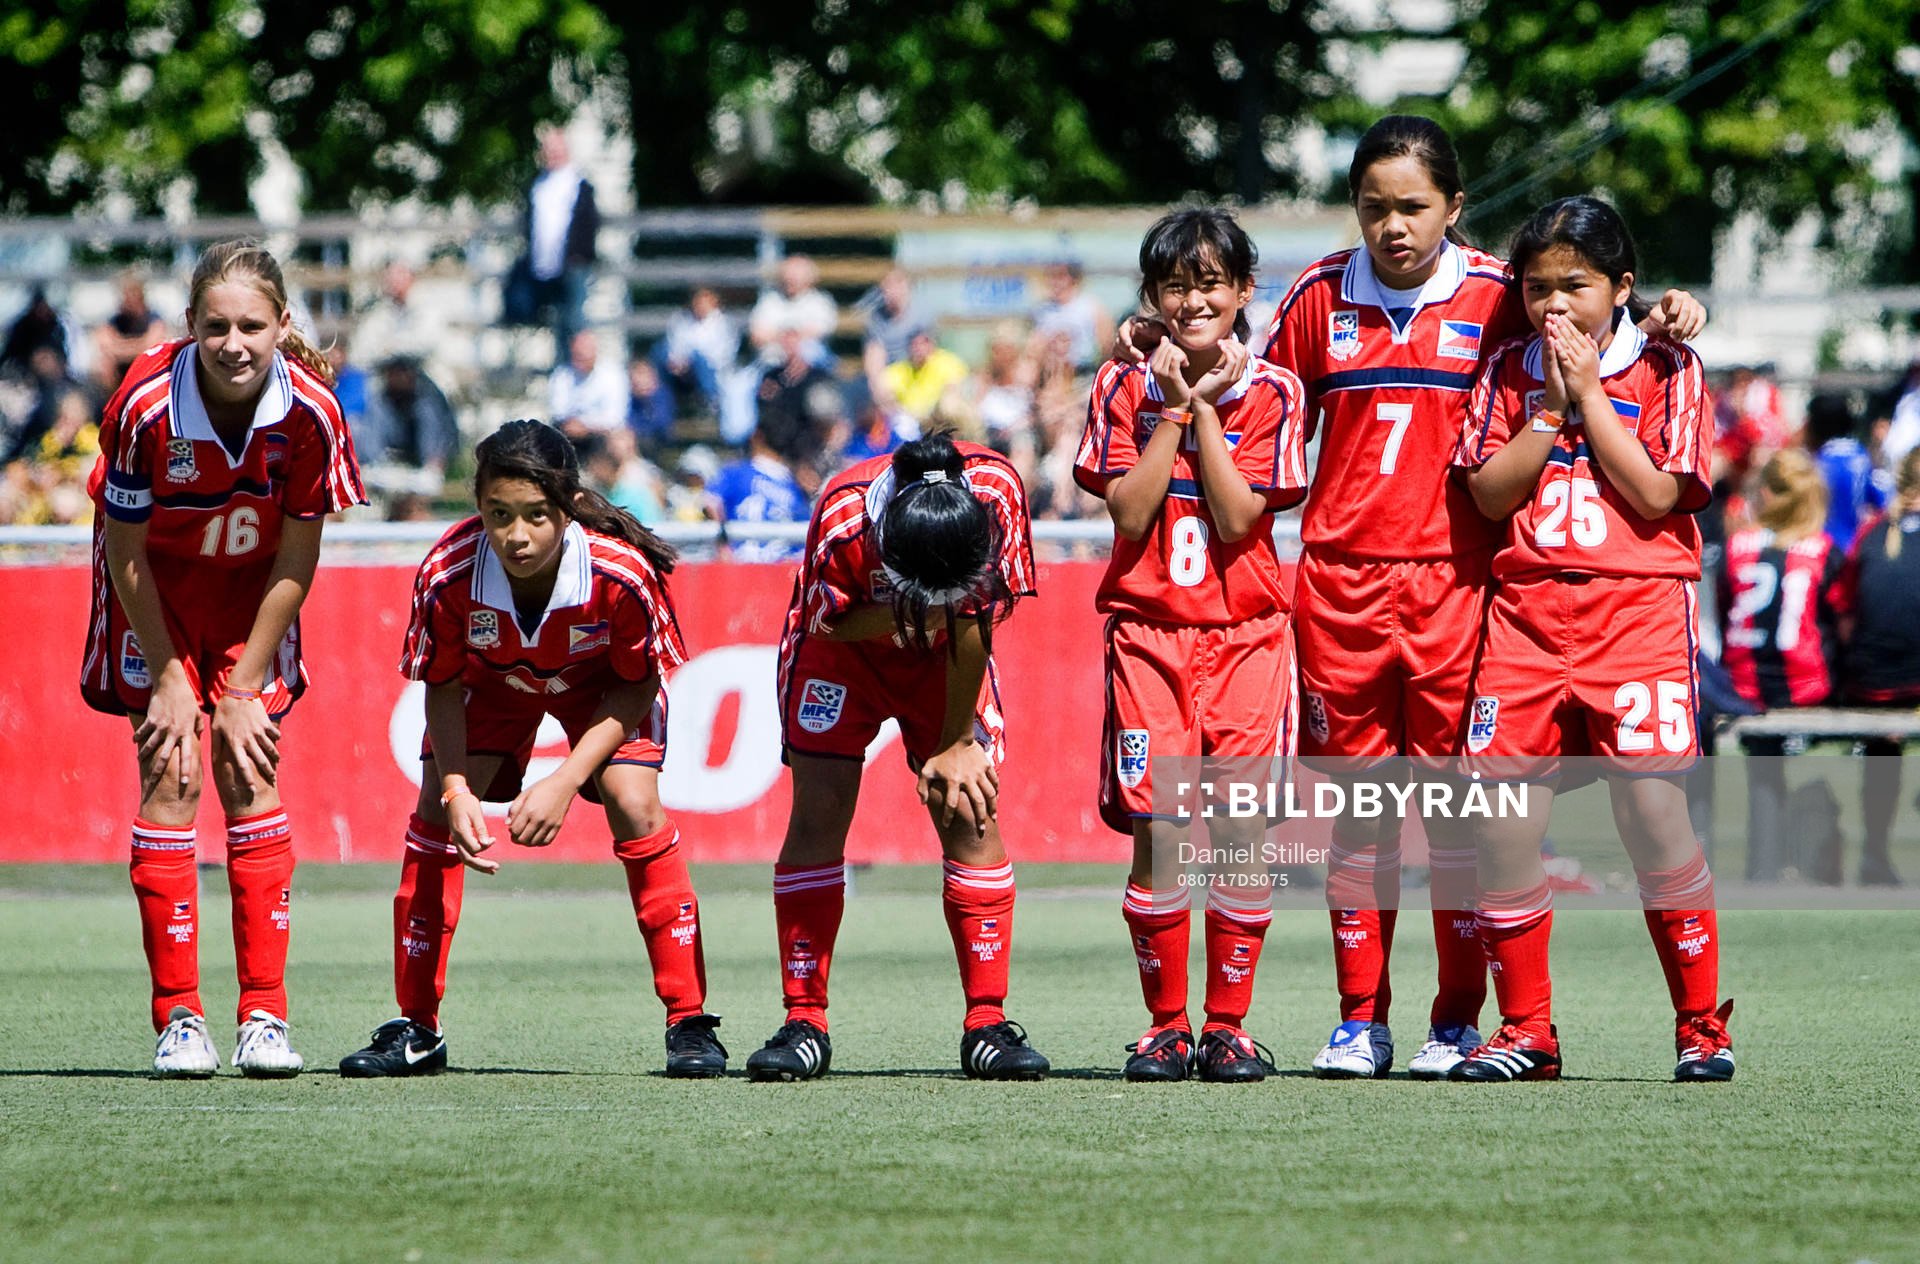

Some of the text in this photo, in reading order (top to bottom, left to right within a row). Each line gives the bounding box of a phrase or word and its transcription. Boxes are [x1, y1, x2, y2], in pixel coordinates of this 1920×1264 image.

[1333, 330, 1357, 341] MFC
[1376, 402, 1414, 475] 7
[105, 482, 137, 506] TEN
[1534, 477, 1608, 548] 25
[200, 506, 260, 557] 16
[1170, 516, 1209, 587] 8
[1727, 562, 1812, 650] 21
[471, 627, 497, 637] MFC
[801, 704, 838, 720] MFC
[1614, 680, 1691, 753] 25
[1452, 917, 1480, 930] MAKA
[402, 936, 430, 951] MAKATI
[971, 942, 1002, 952] MAKATI
[787, 959, 817, 971] MAKATI
